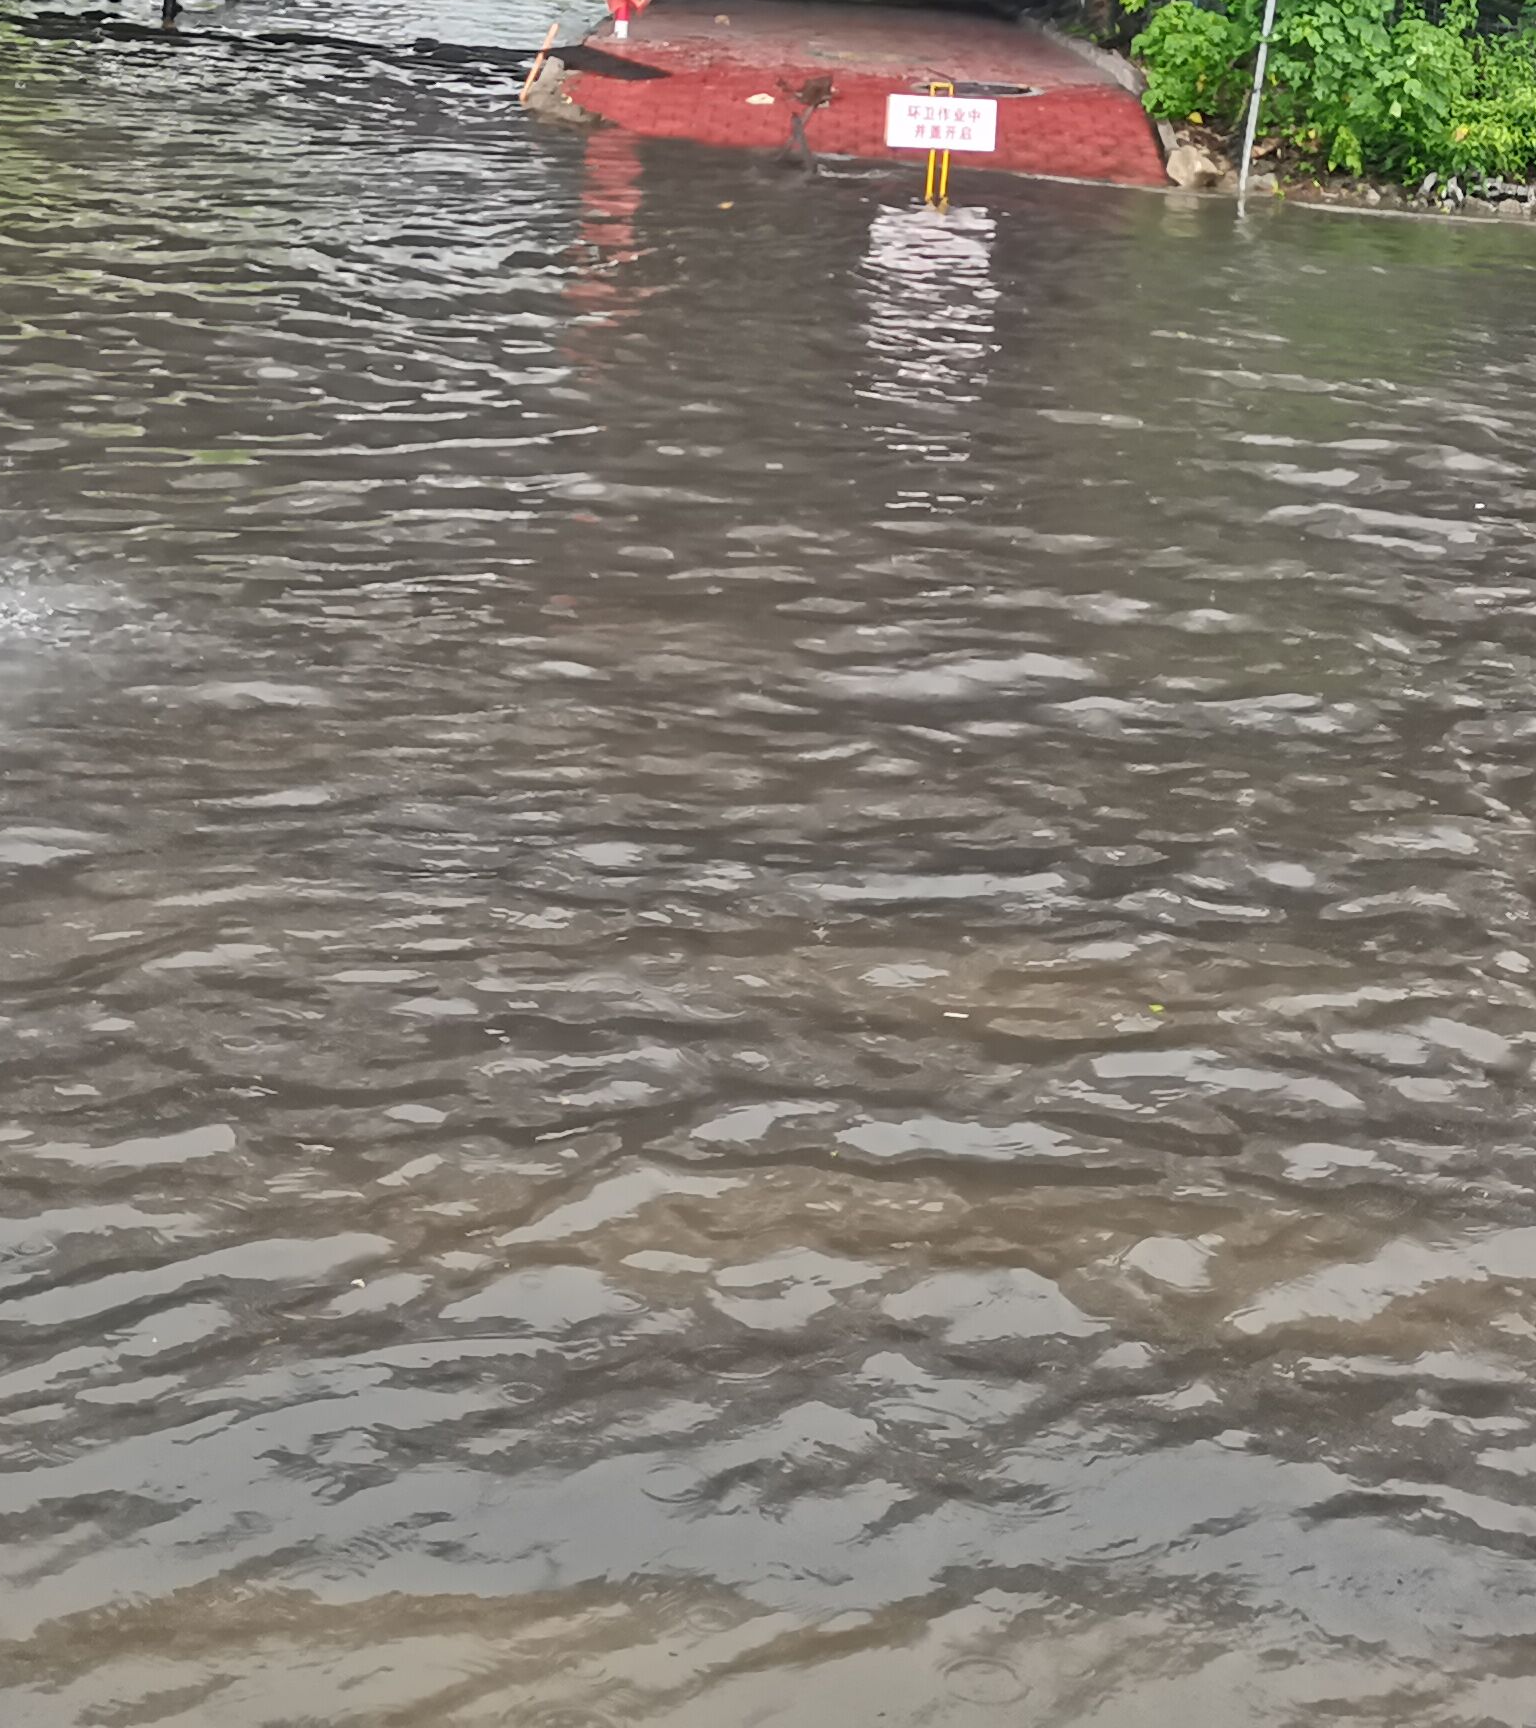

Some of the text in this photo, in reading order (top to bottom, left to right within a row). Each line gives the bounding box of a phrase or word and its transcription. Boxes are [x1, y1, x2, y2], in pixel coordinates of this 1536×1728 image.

[907, 105, 981, 123] 环卫作业中
